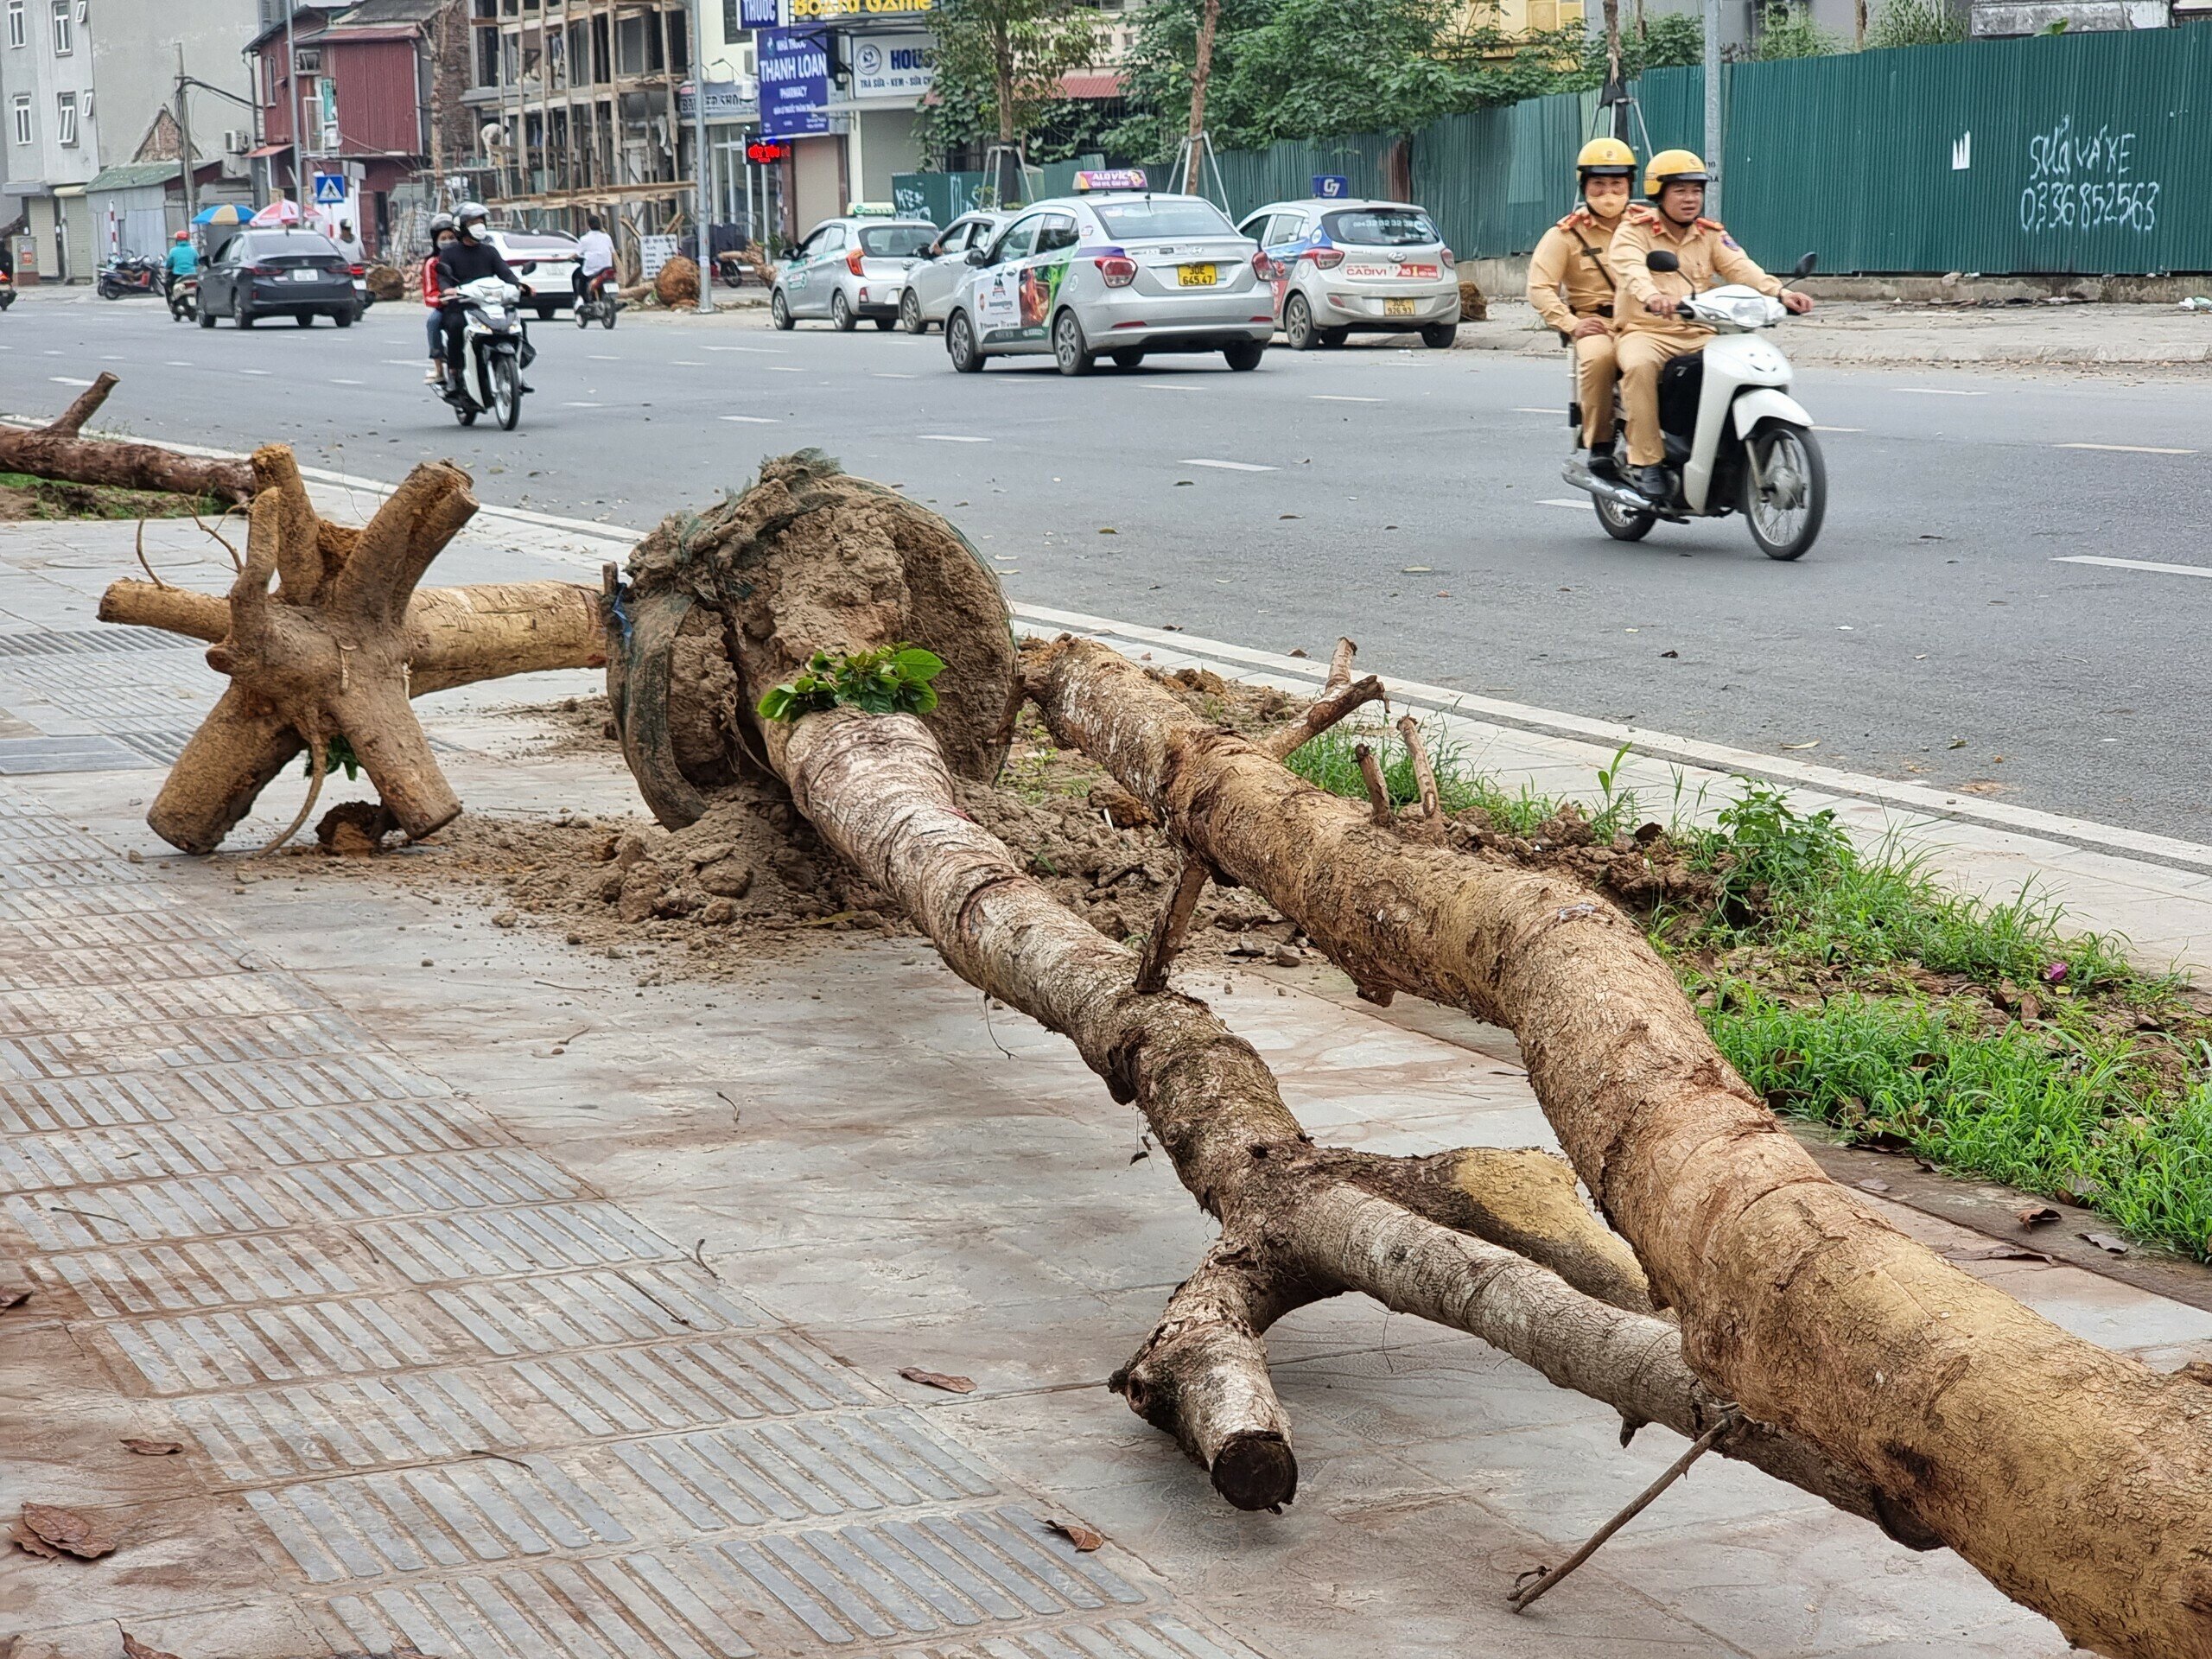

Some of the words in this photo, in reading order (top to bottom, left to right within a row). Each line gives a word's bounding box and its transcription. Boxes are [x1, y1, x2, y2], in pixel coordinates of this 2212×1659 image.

[760, 56, 796, 83] THANH
[797, 52, 827, 79] LOAN
[1323, 178, 1340, 197] G7
[1182, 276, 1212, 285] 645.47
